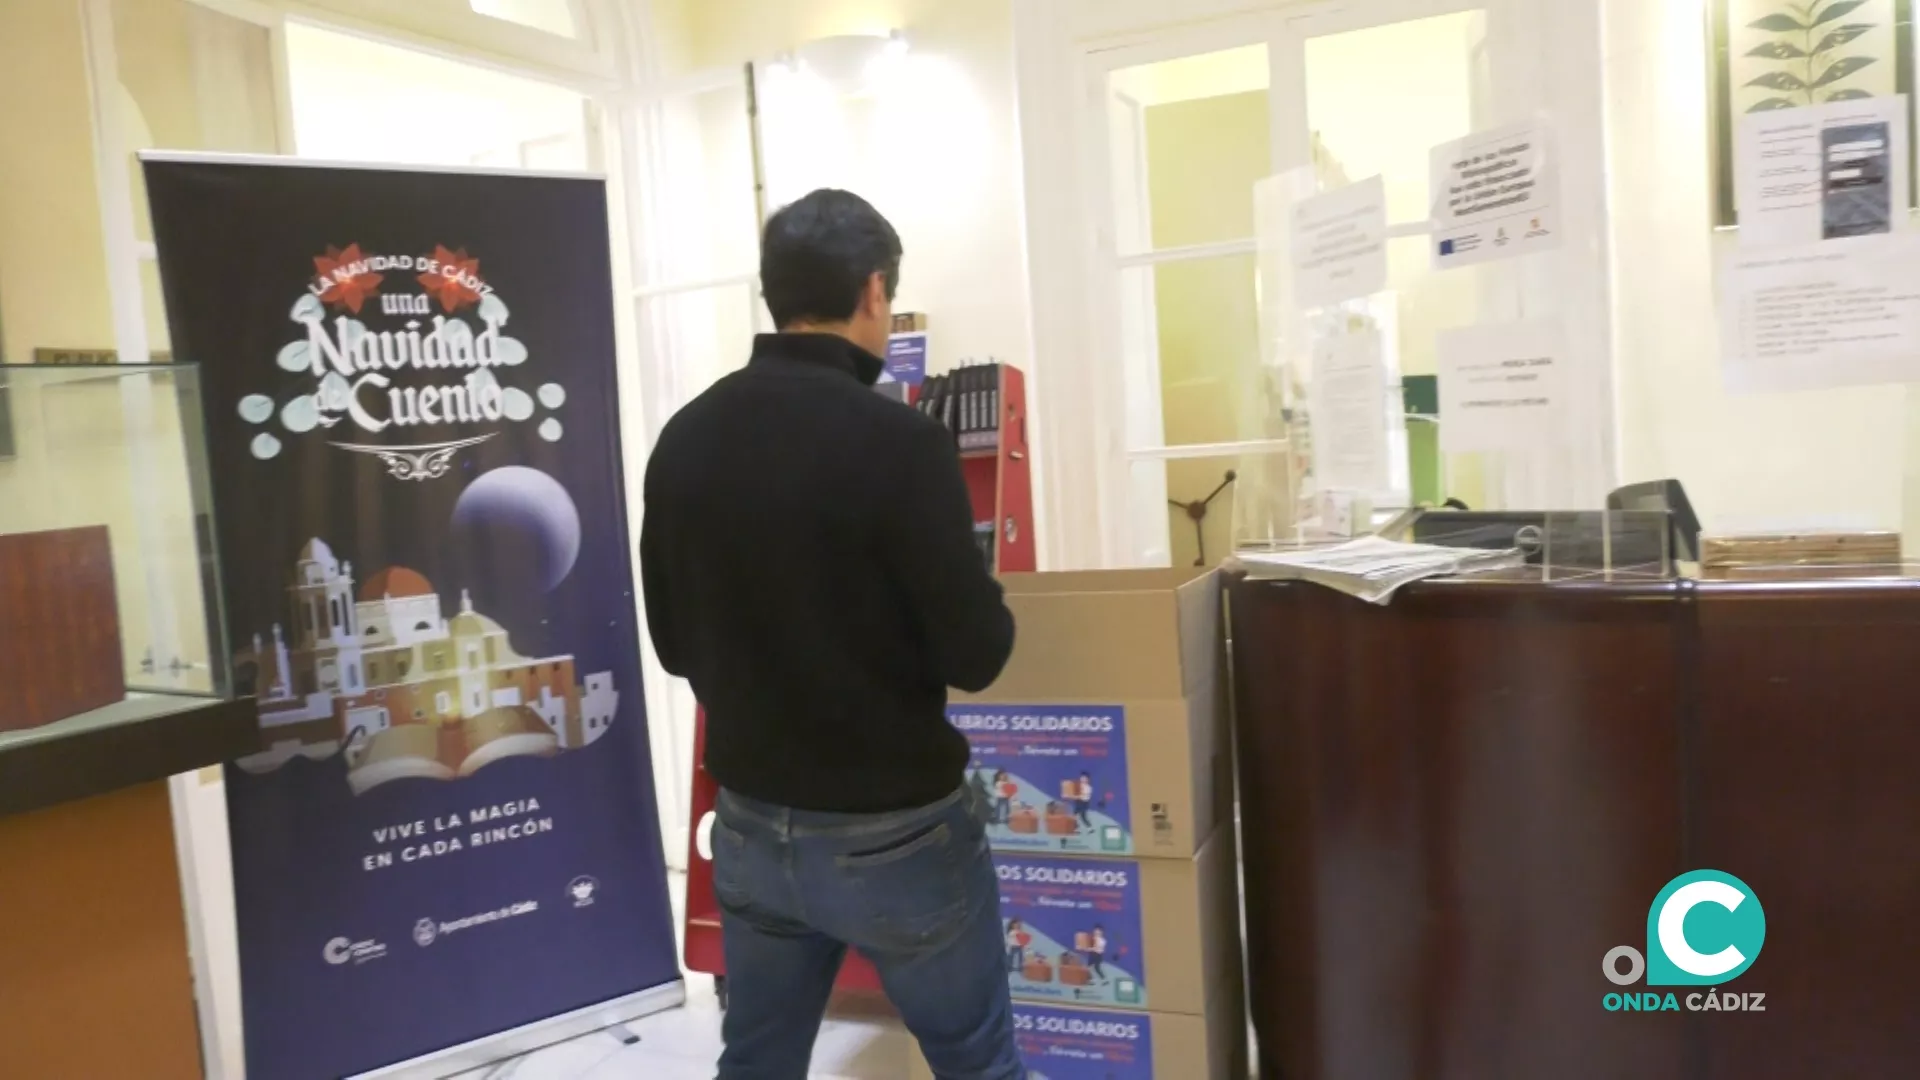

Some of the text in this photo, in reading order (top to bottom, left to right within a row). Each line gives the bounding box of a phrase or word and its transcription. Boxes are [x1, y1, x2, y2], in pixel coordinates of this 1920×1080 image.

[308, 275, 336, 296] LA
[332, 254, 414, 282] NAVIDAD
[415, 256, 440, 275] DE
[381, 292, 431, 316] una
[299, 313, 508, 377] Navidad
[1011, 714, 1114, 732] SOLIDARIOS
[373, 797, 541, 844] VIVE LA MAGIA
[362, 816, 553, 872] EN CADA RINCÓN
[1024, 866, 1128, 887] SOLIDARIOS
[1036, 1016, 1140, 1039] SOLIDARIOS
